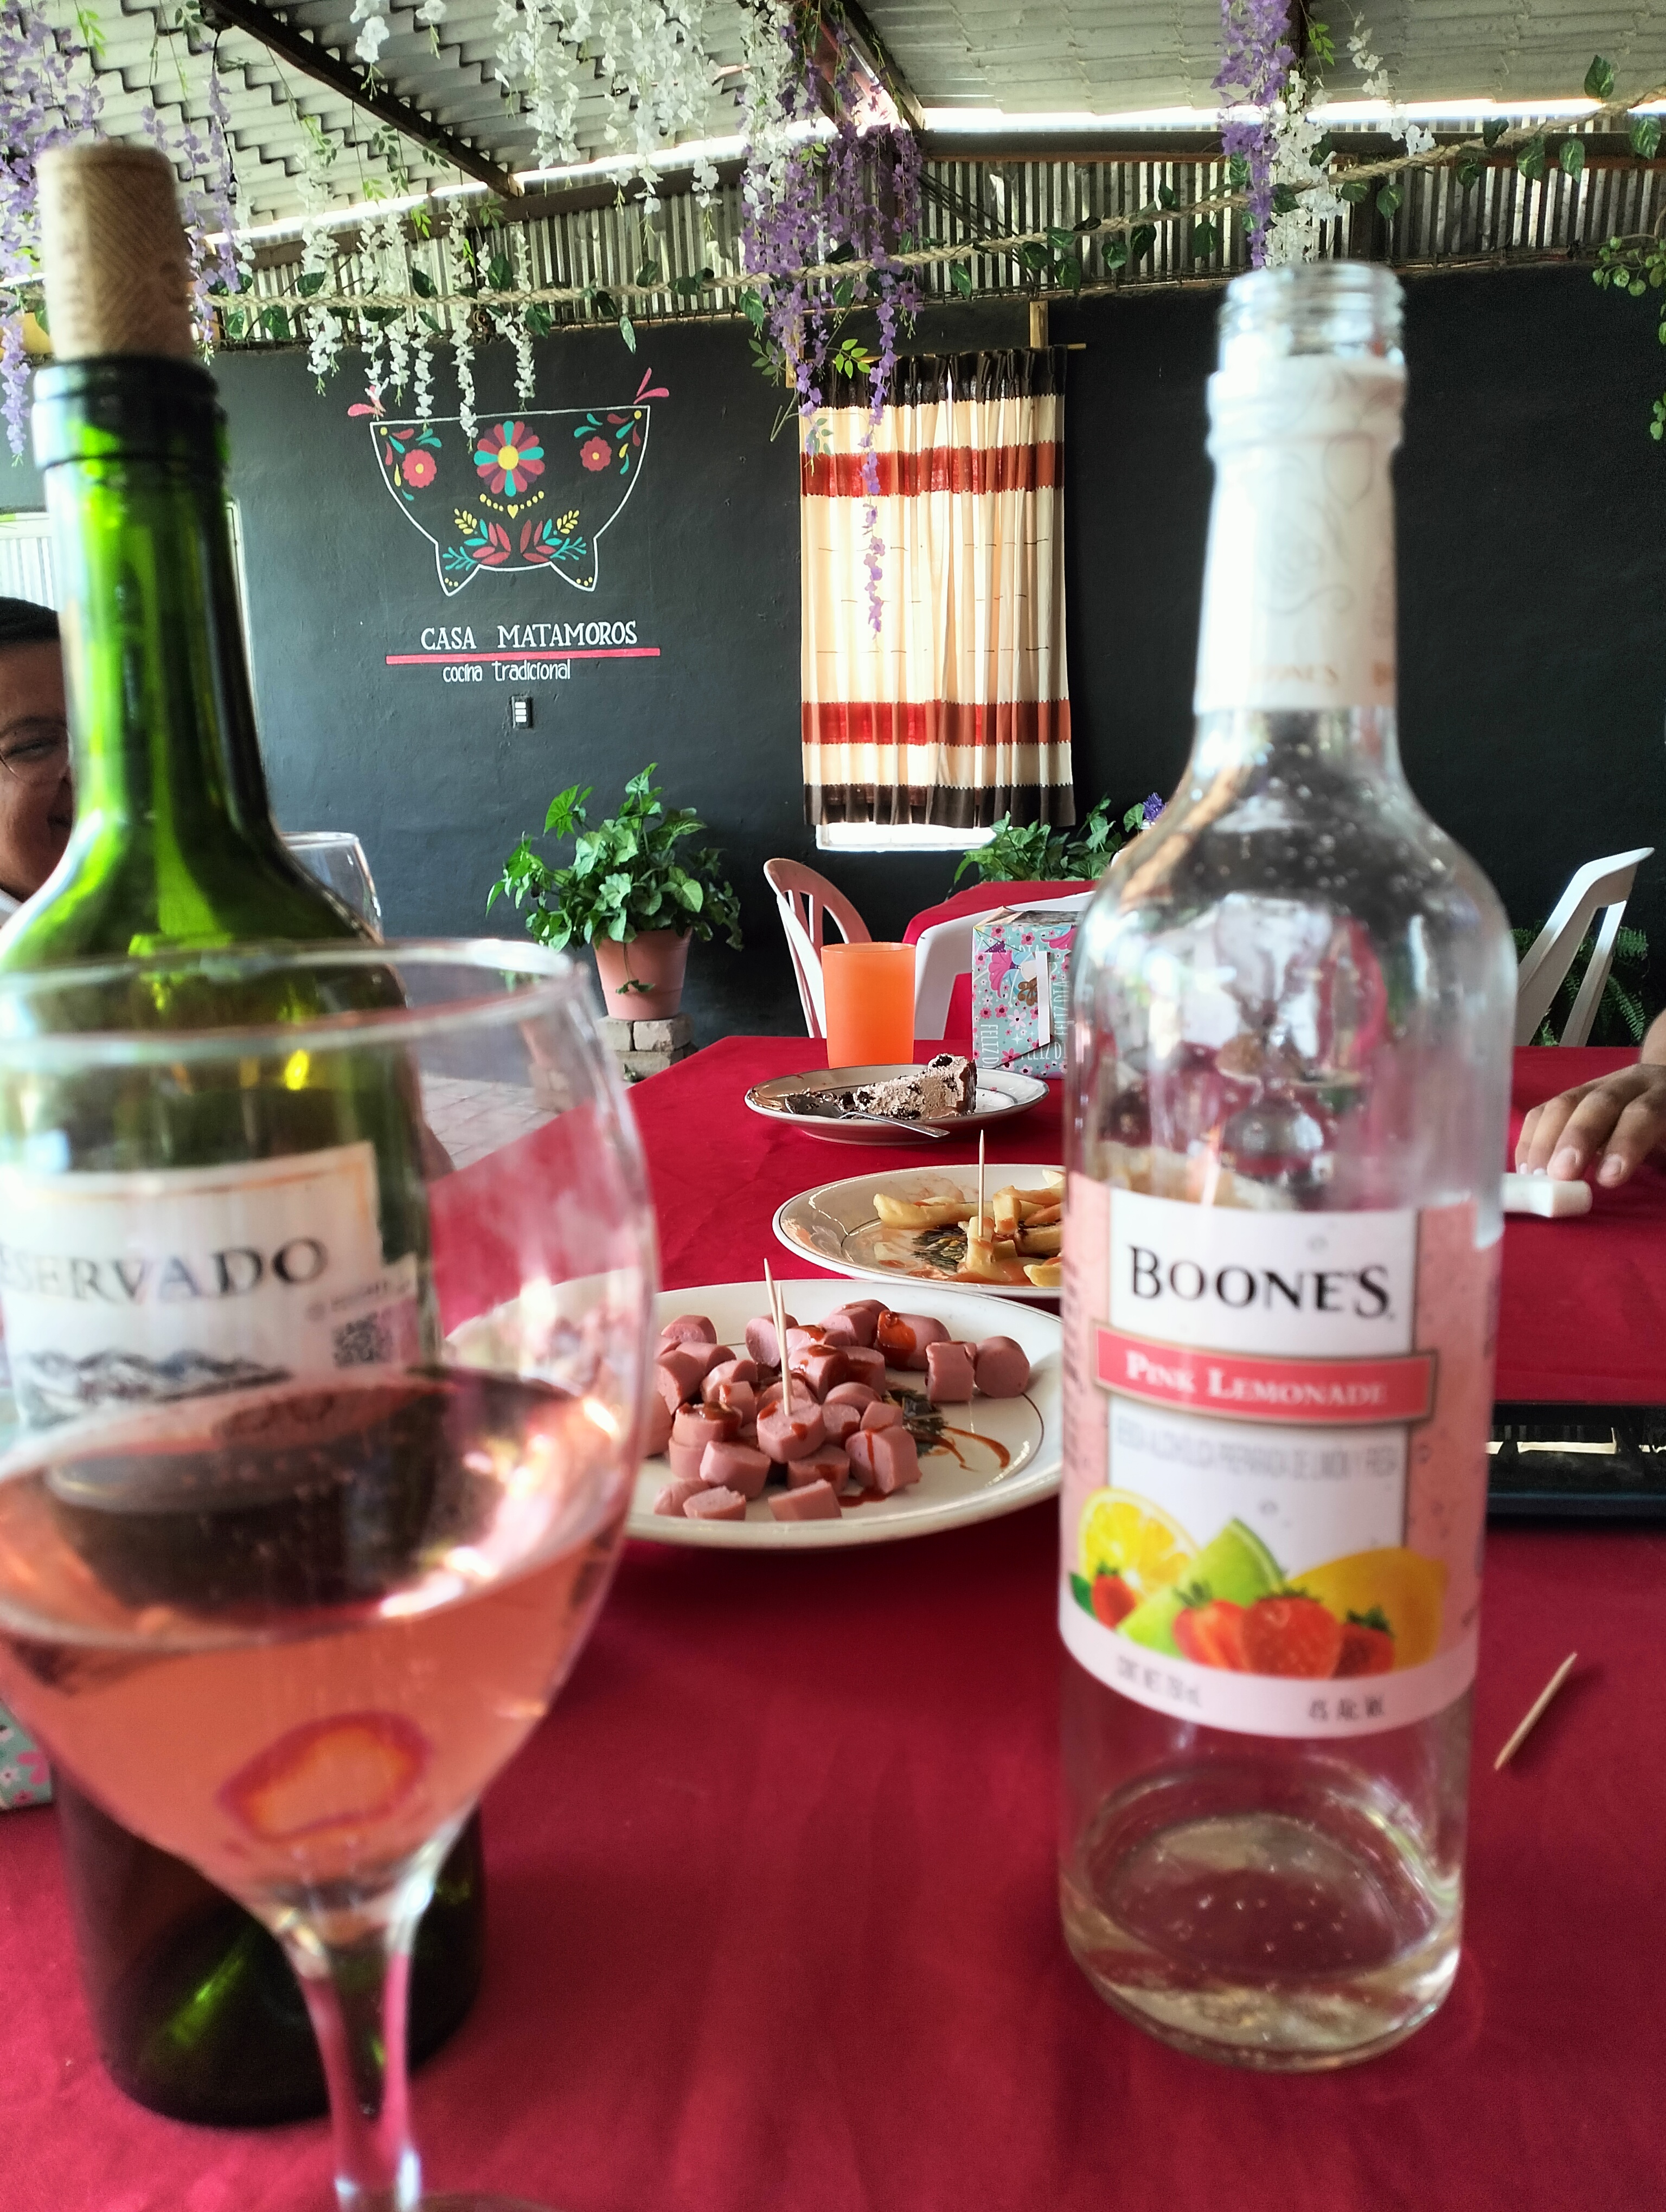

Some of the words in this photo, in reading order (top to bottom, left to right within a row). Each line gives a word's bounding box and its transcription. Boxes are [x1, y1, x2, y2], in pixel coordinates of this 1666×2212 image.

[421, 626, 477, 650] CASA
[497, 620, 638, 648] MATAMOROS
[443, 663, 483, 683] cocina
[491, 659, 571, 682] tradicional
[980, 1024, 999, 1054] FELIZ
[1126, 1351, 1195, 1393] PINK
[1208, 1367, 1385, 1406] LEMONADE
